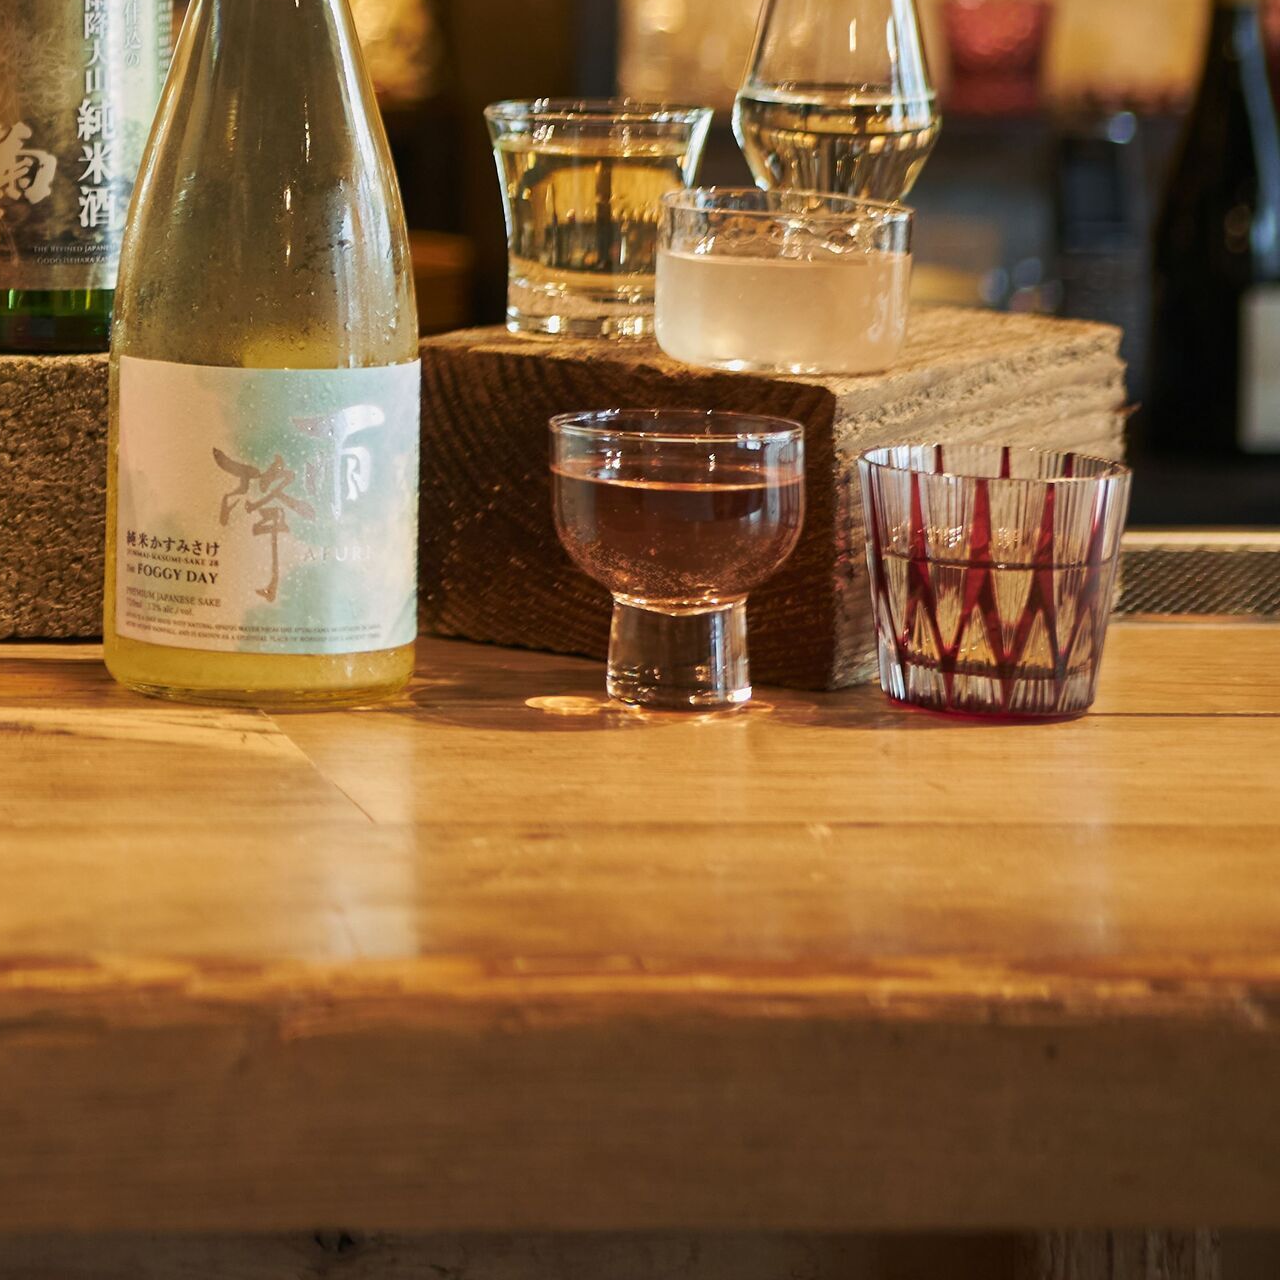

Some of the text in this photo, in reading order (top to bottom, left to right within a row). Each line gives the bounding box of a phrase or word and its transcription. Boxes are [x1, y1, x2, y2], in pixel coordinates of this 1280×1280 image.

[127, 530, 219, 557] 純米かすみさけ
[304, 545, 371, 562] AFURI
[137, 563, 181, 581] FOGGY
[186, 570, 218, 584] DAY
[198, 597, 221, 608] SAKE
